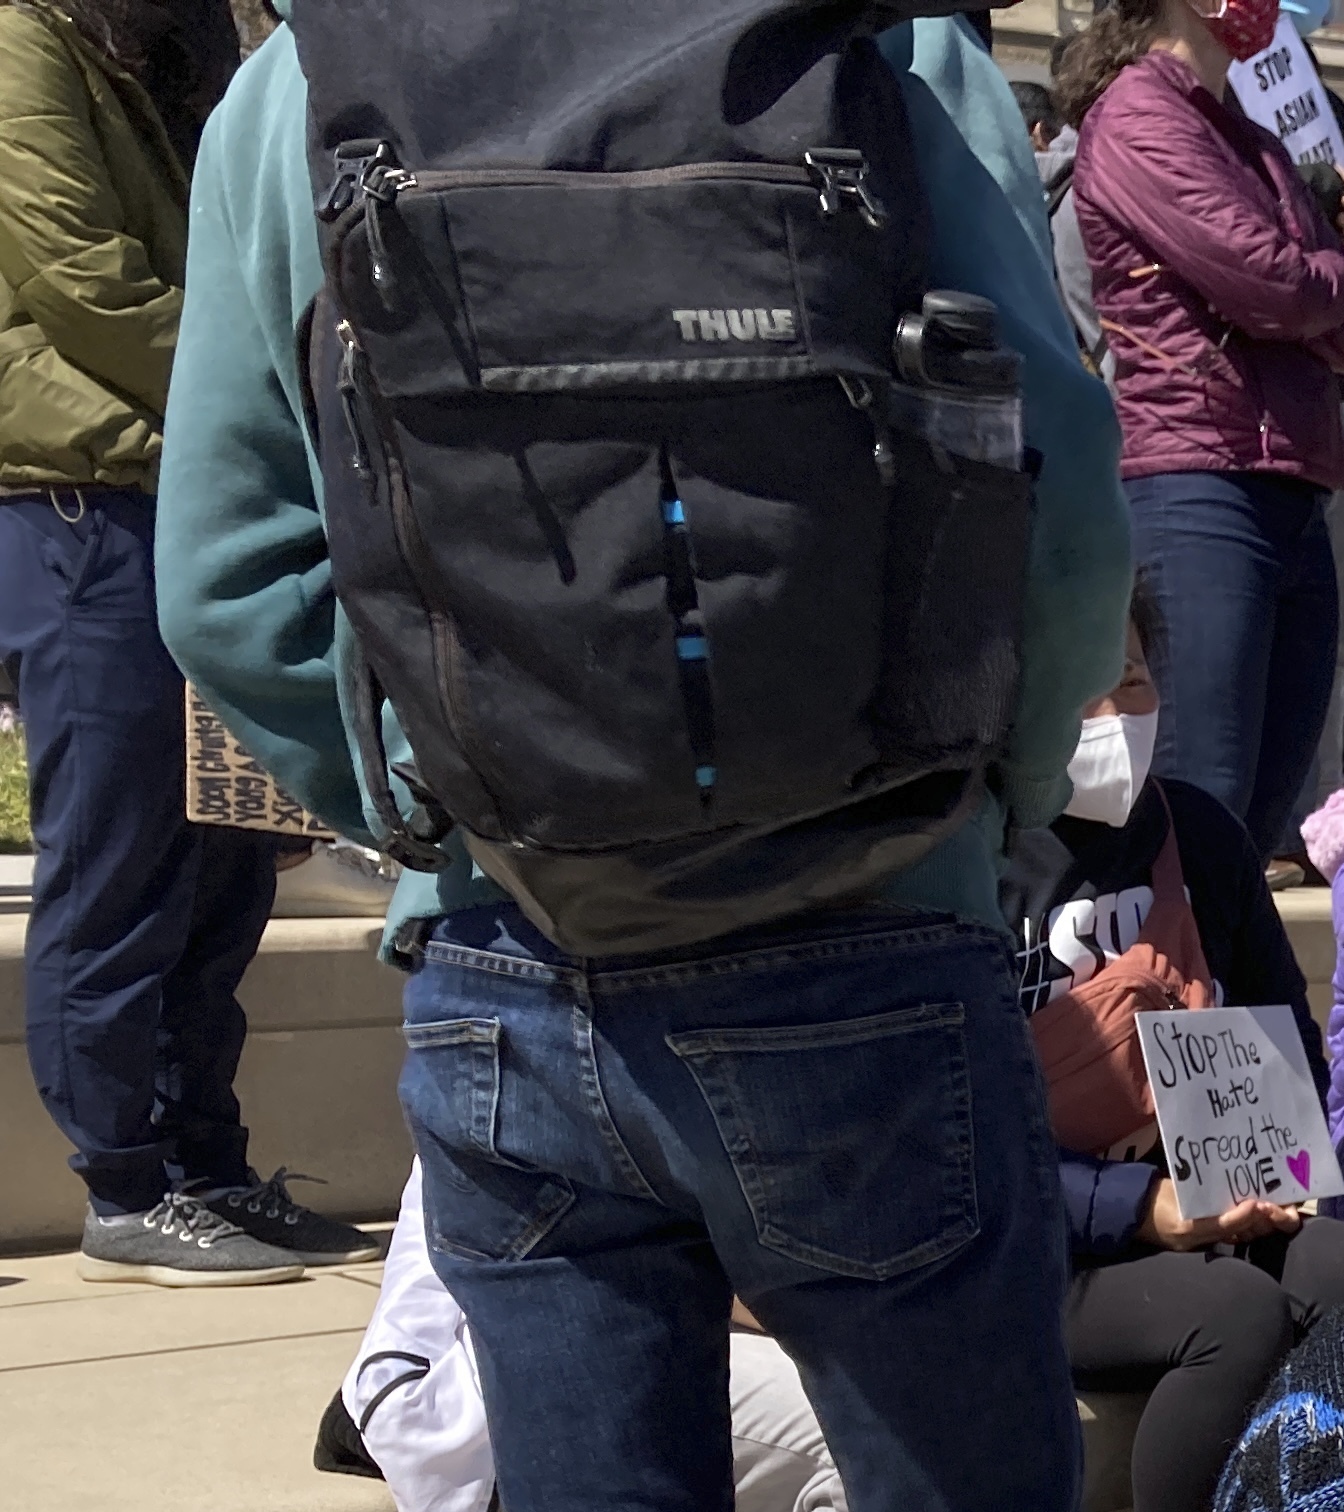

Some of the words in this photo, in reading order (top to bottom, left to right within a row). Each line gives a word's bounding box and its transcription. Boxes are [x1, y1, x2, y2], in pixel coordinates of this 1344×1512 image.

[1253, 46, 1294, 92] STOP
[1274, 88, 1321, 140] ASIAN
[672, 308, 796, 341] THULE
